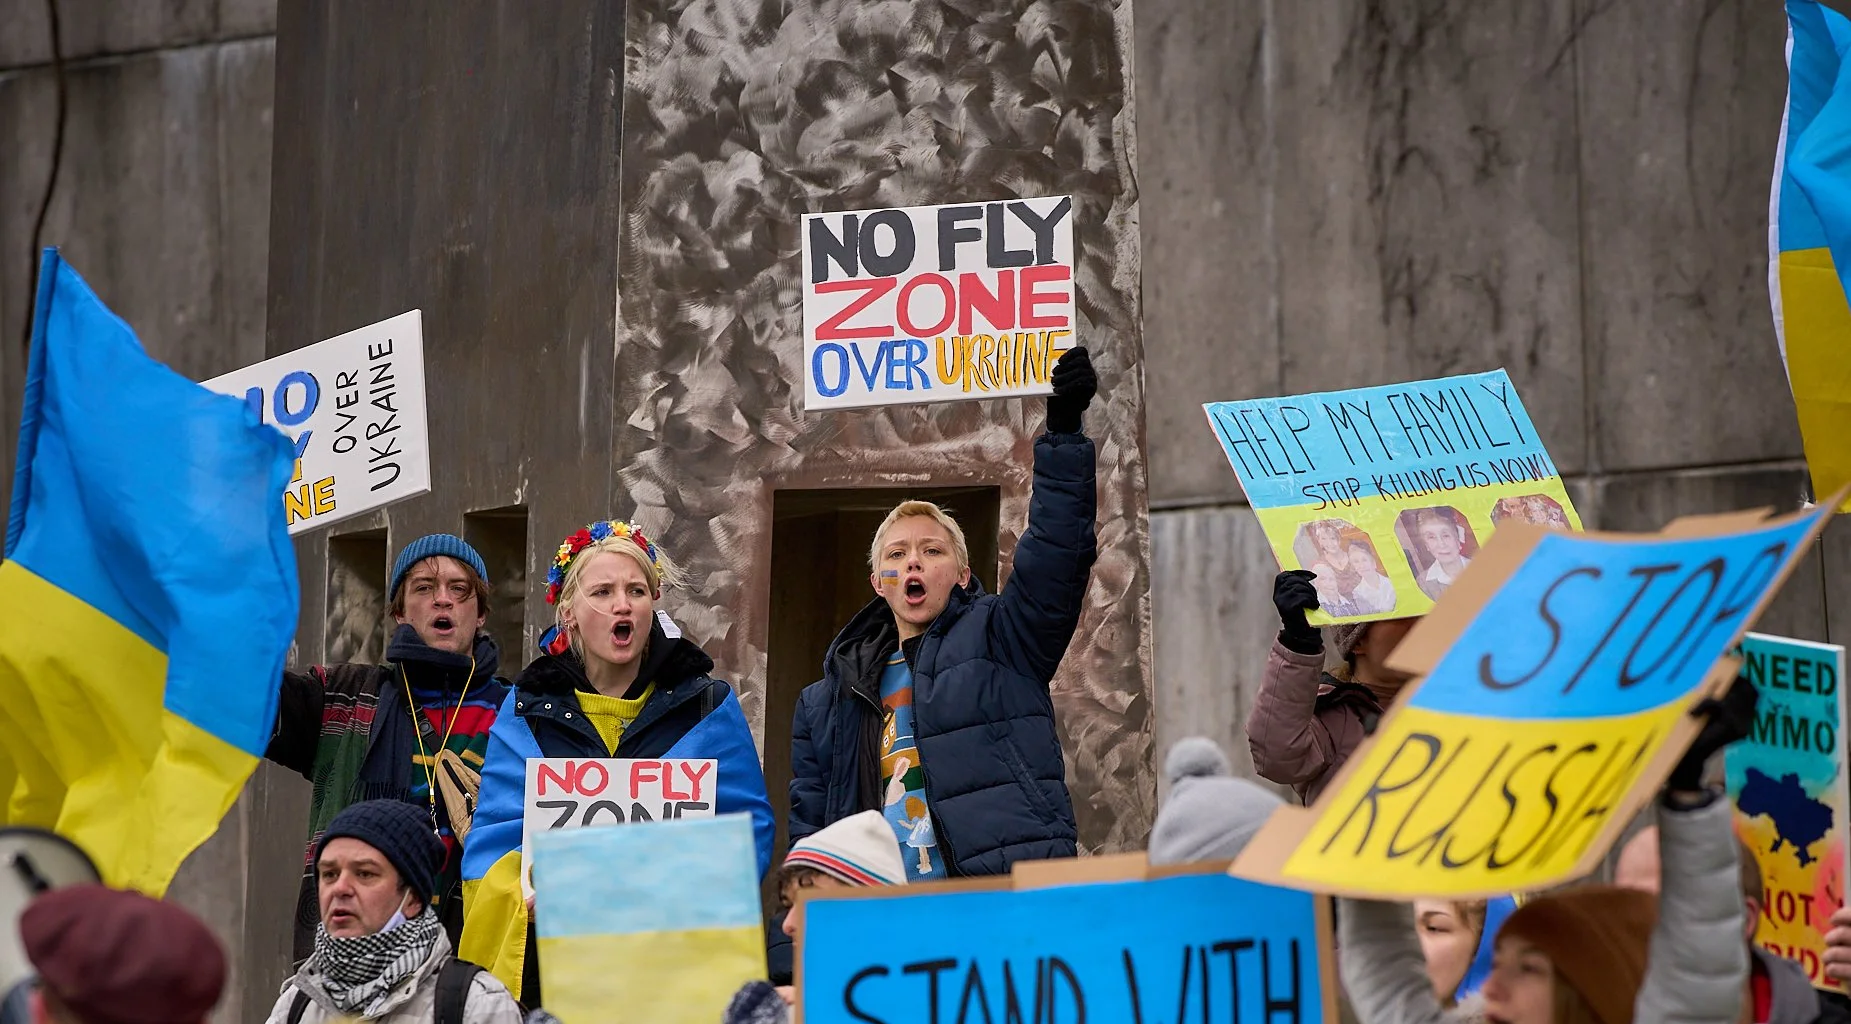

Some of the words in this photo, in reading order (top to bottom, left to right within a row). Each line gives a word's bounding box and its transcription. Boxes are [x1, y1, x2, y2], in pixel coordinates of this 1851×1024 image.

[809, 210, 915, 283] NO
[937, 196, 1071, 271] FLY
[814, 265, 1070, 340] ZONE
[811, 340, 932, 397] OVER
[935, 330, 1072, 393] UKRAINE
[333, 370, 358, 453] OVER
[366, 339, 401, 491] UKRAINE
[1212, 406, 1316, 479] HELP
[1322, 401, 1393, 465] MY
[1387, 382, 1526, 459] FAMILY
[284, 476, 336, 525] NE
[1302, 477, 1360, 511] STOP
[1370, 467, 1457, 502] KILLING
[1456, 463, 1491, 490] US
[1489, 453, 1555, 487] NOW!
[1478, 540, 1787, 694] STOP
[1744, 651, 1837, 696] NEED
[1749, 711, 1836, 755] MMO
[537, 761, 609, 796] NO
[630, 761, 711, 801] FLY
[1320, 727, 1658, 869] RUSSIA
